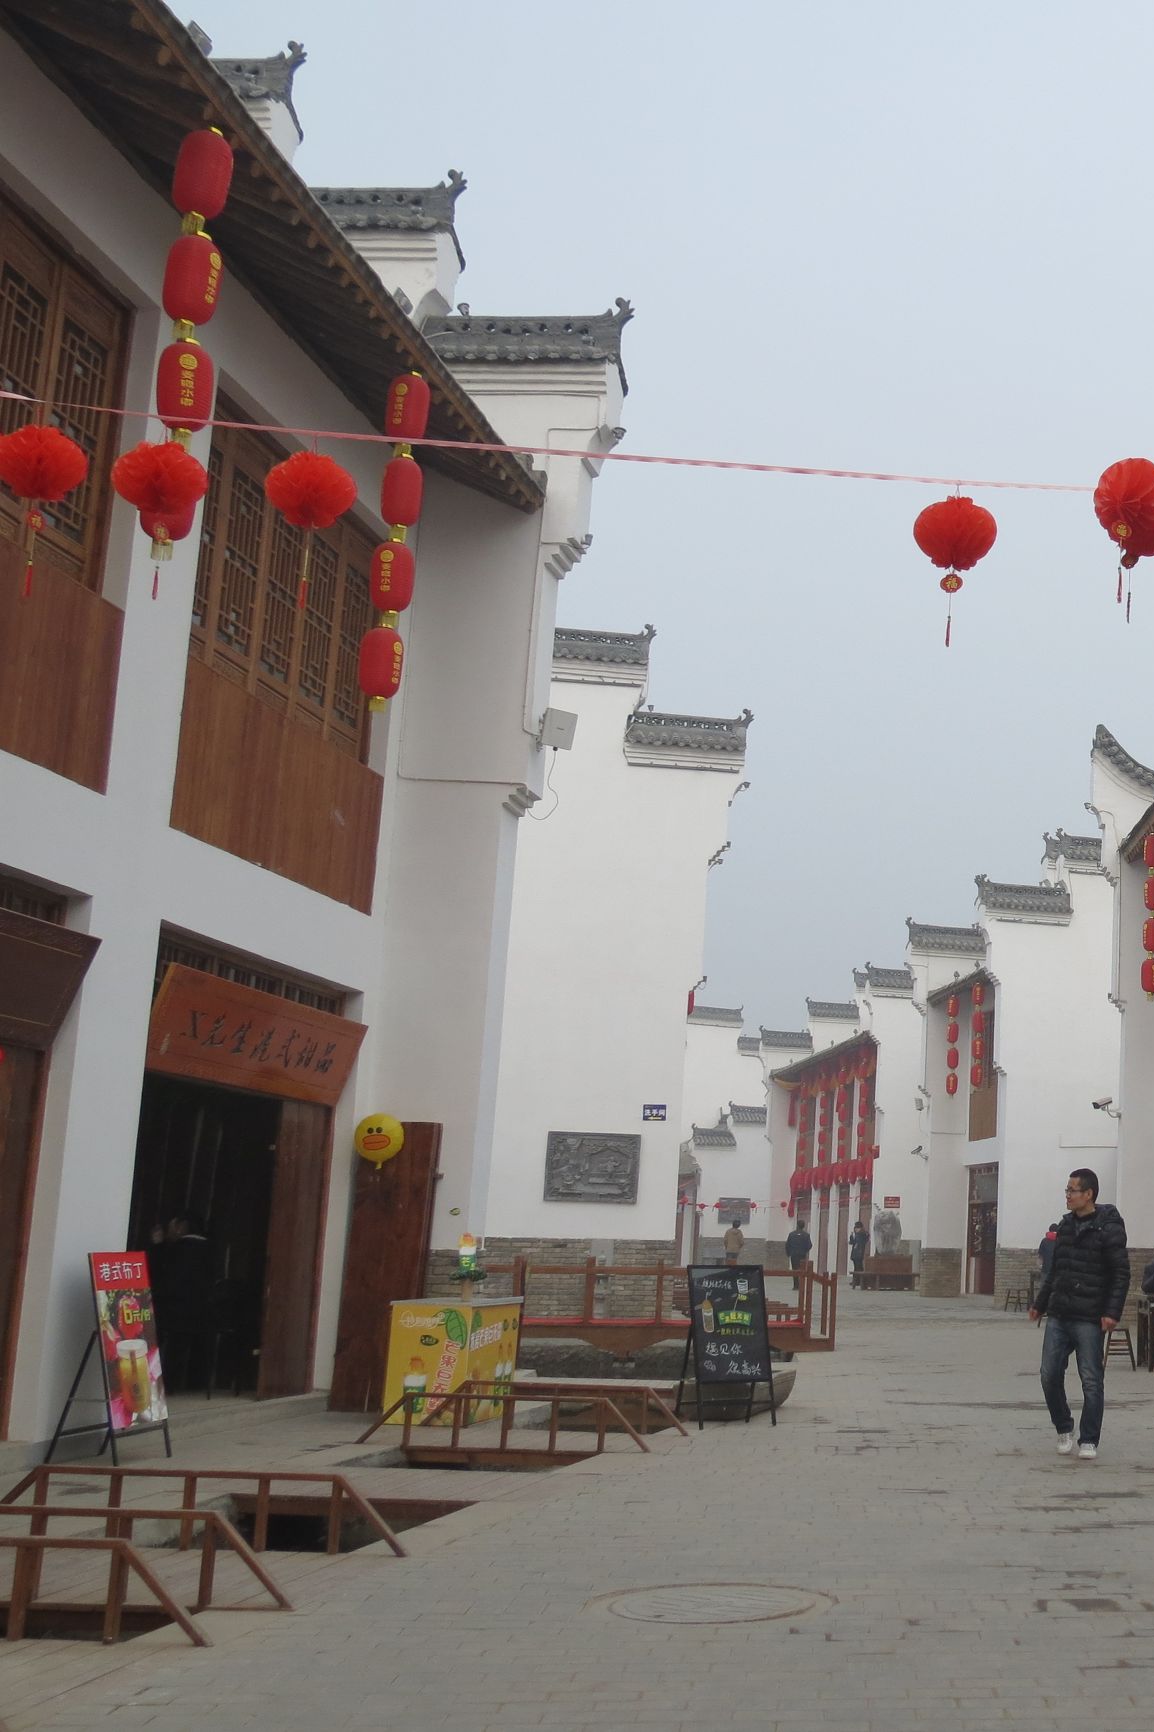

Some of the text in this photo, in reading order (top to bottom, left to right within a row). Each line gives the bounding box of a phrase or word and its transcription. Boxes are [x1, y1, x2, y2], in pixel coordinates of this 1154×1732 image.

[946, 576, 957, 589] 福
[99, 1262, 143, 1282] 港式布丁
[705, 1342, 743, 1357] 遇见你
[726, 1360, 763, 1376] 很高兴
